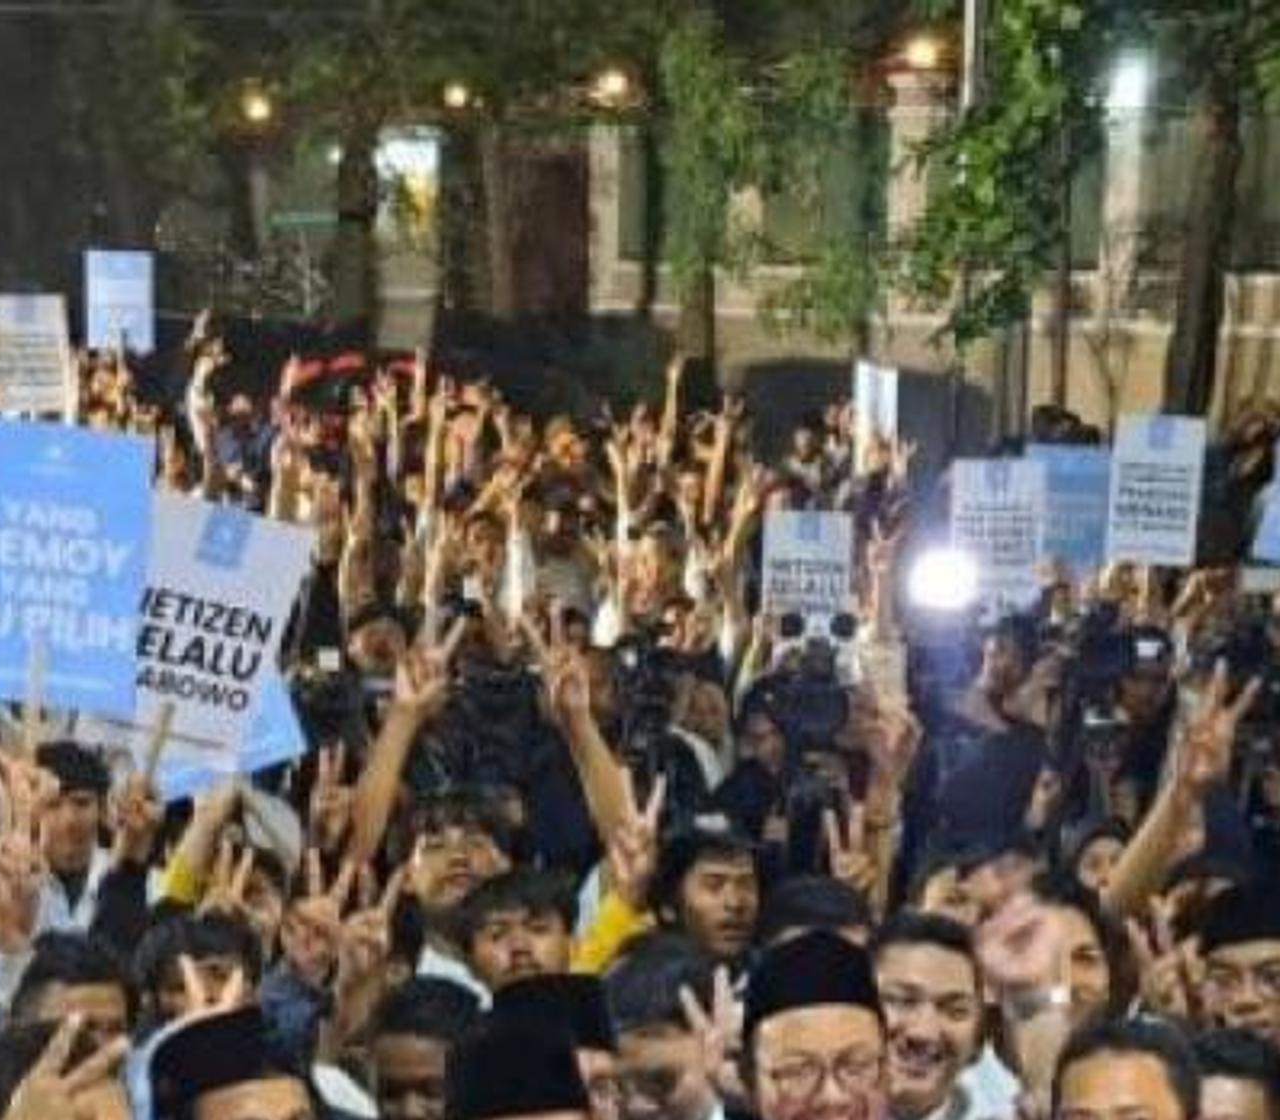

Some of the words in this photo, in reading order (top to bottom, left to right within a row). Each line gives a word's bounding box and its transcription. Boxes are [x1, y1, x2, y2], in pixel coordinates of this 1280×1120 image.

[2, 500, 99, 533] YANG
[0, 569, 90, 606] YANG
[23, 605, 133, 653] PILIH
[136, 626, 263, 681] ELALU
[136, 670, 250, 712] ABOWO
